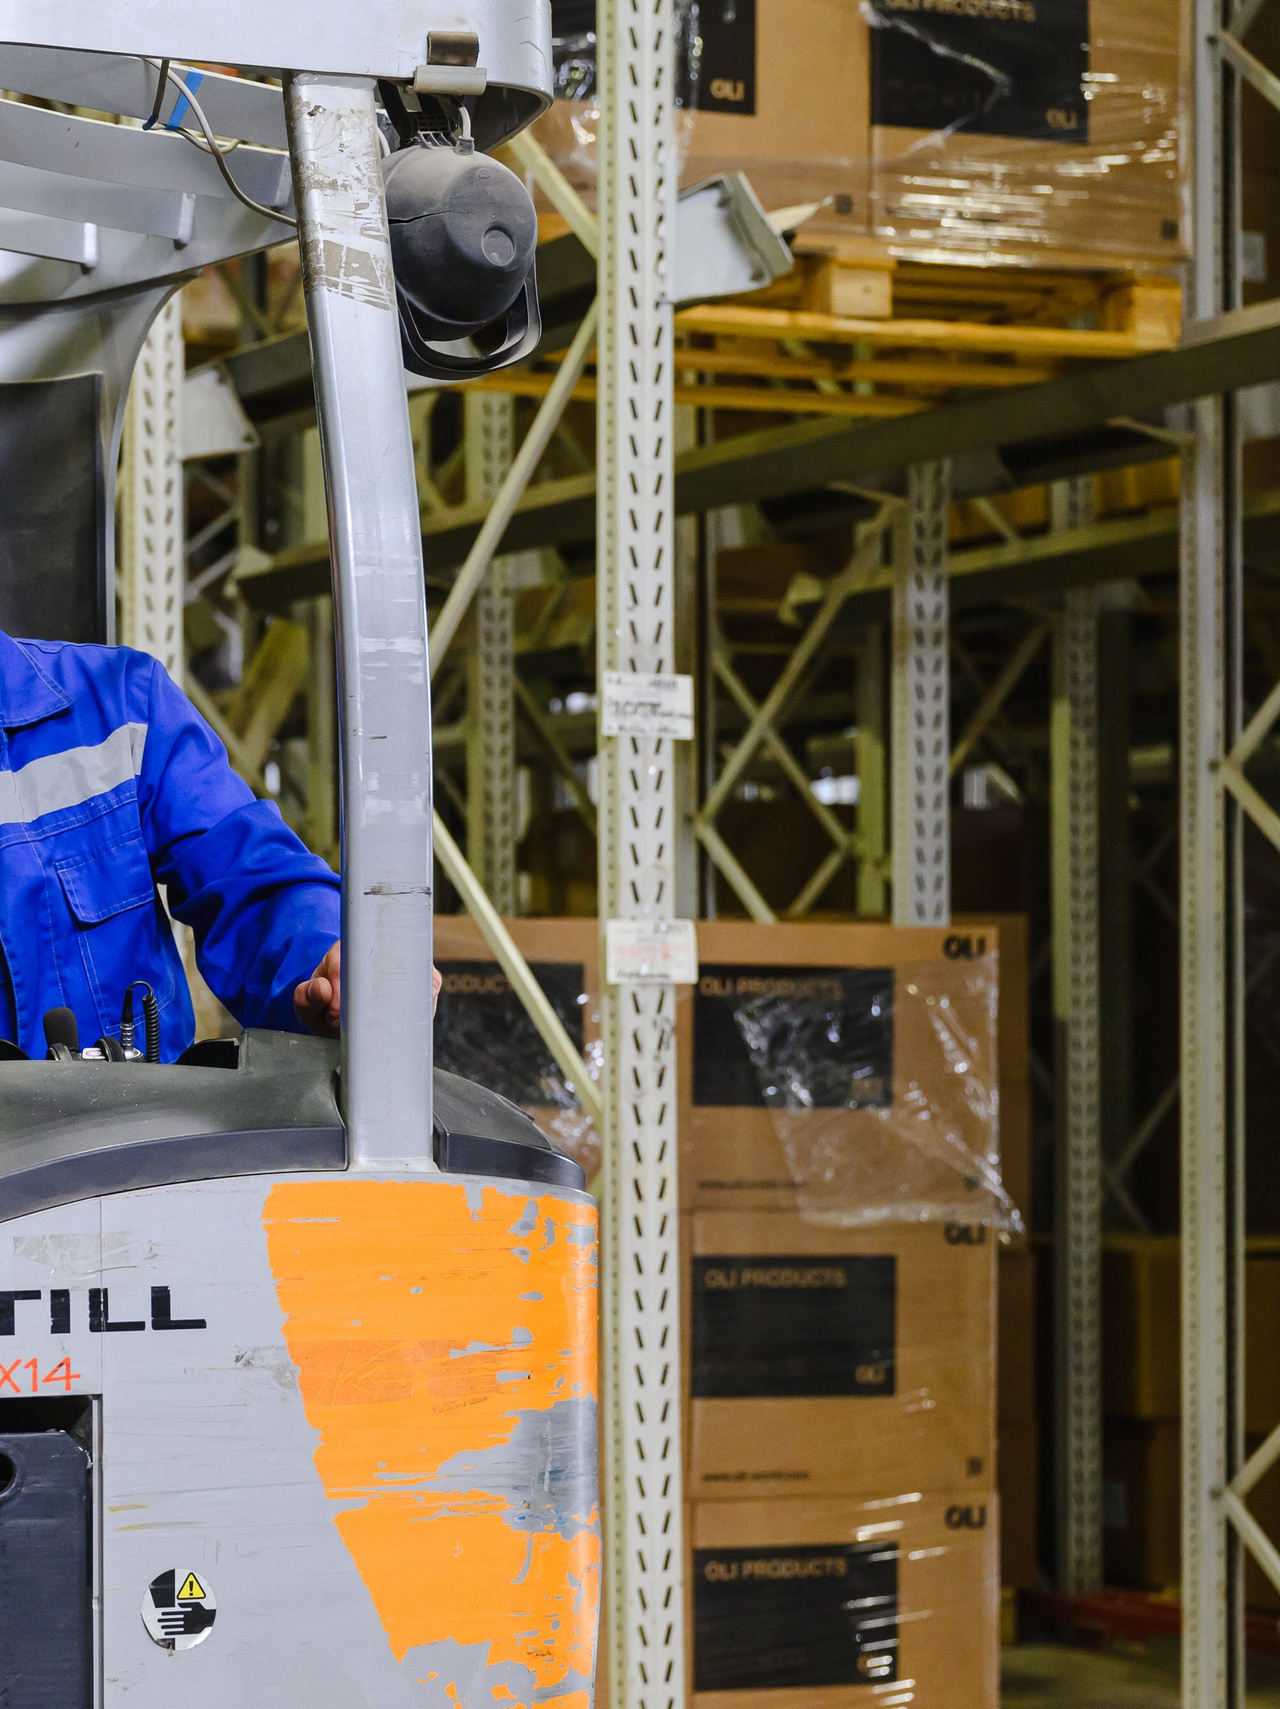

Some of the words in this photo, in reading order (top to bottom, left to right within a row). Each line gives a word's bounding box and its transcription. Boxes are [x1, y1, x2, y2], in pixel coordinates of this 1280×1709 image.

[709, 79, 745, 101] OLI
[943, 934, 987, 960] OLI
[700, 974, 733, 998] OLI
[944, 1221, 987, 1246] OLI
[704, 1267, 738, 1290] OLI
[741, 1266, 848, 1289] PRODUCTS
[944, 1505, 987, 1531] OLI
[704, 1560, 739, 1582] OLI
[742, 1557, 848, 1580] PRODUCTS
